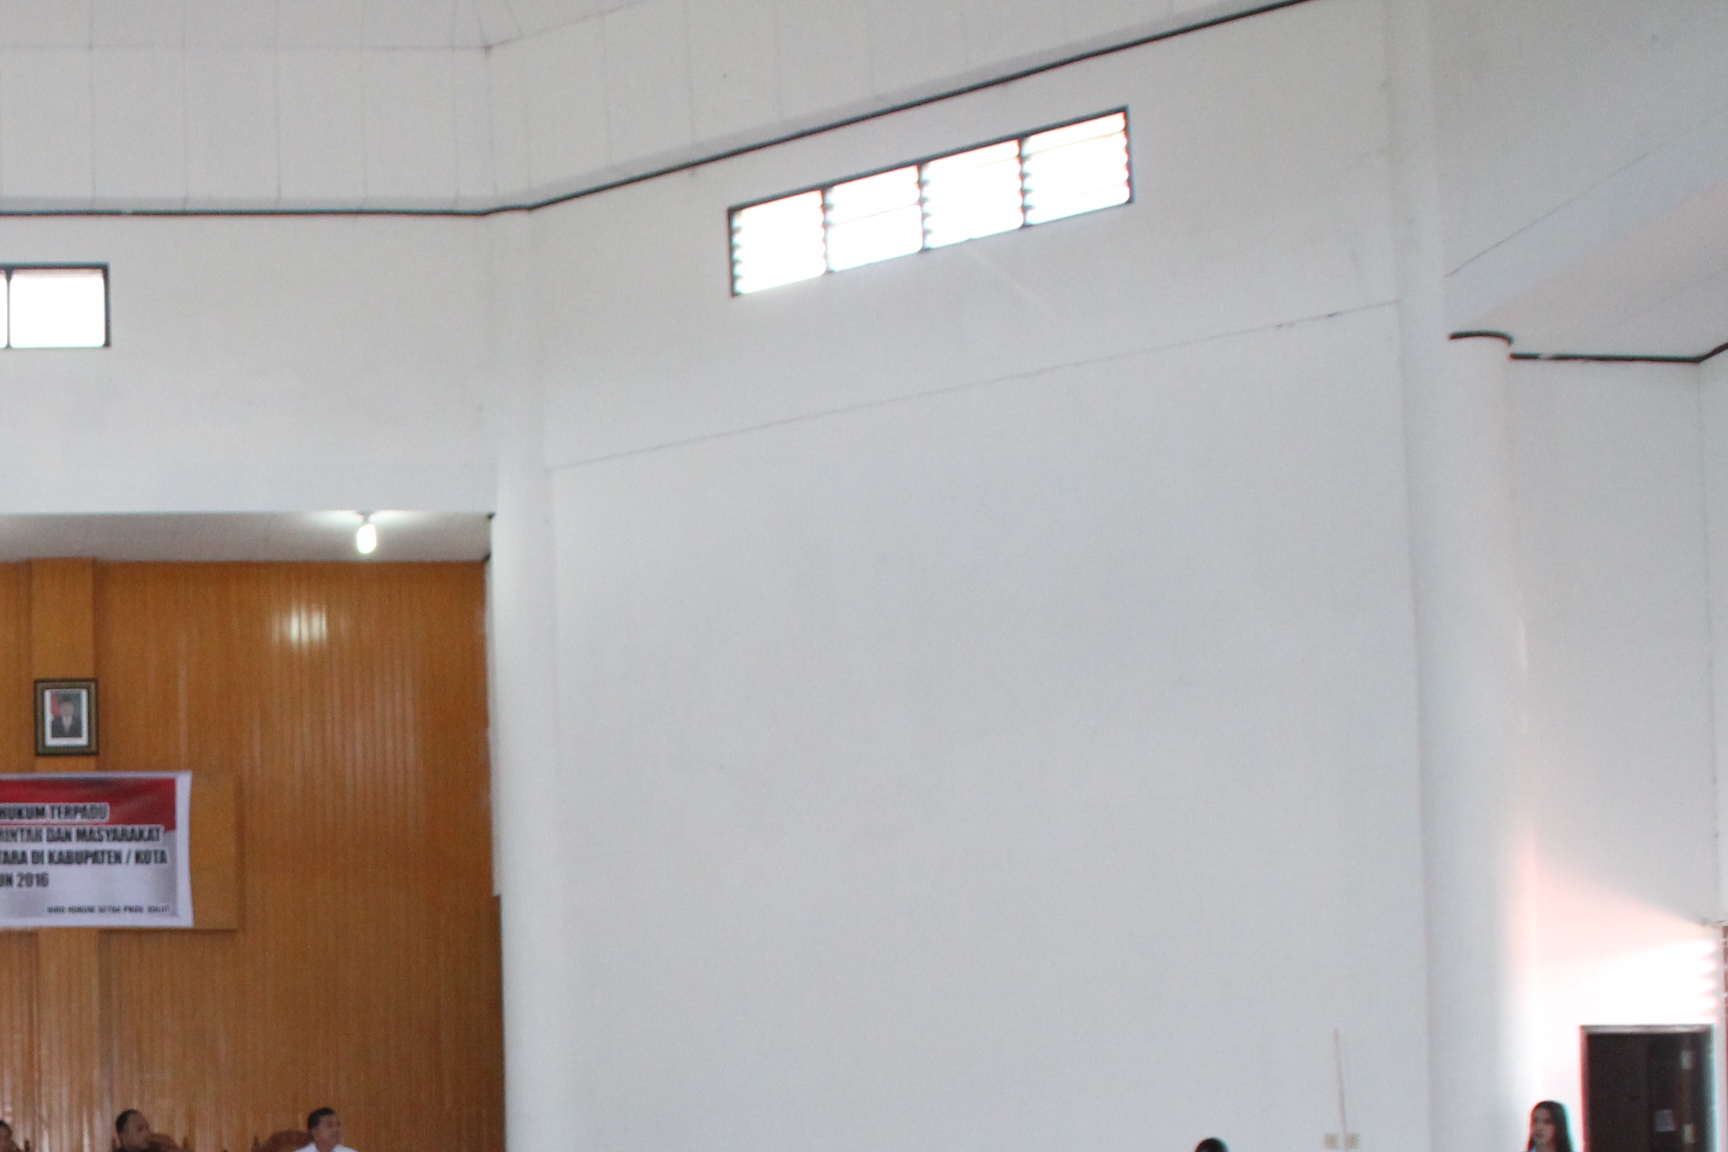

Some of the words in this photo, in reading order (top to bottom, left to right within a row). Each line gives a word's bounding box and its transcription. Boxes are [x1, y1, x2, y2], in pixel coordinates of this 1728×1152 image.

[50, 803, 108, 820] TERPADU
[46, 827, 72, 842] DAN
[76, 826, 161, 842] MASYARAKAT
[31, 850, 45, 865] DI
[48, 850, 123, 865] KABUPATEN
[135, 849, 168, 865] KOTA
[17, 872, 49, 888] 2016
